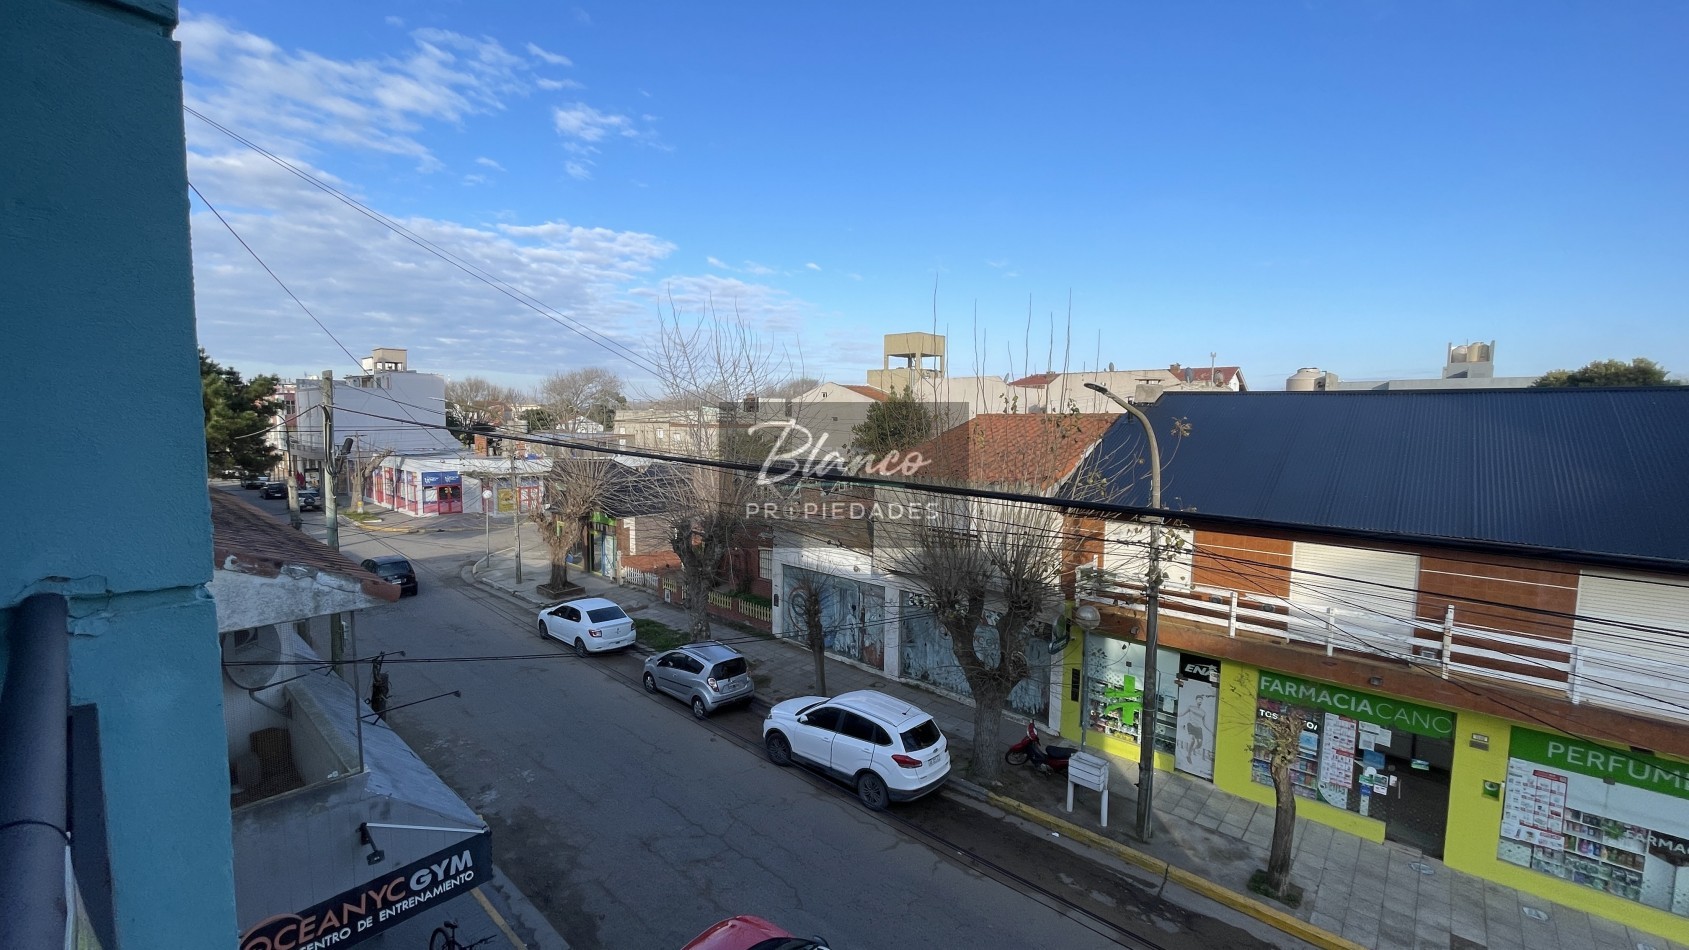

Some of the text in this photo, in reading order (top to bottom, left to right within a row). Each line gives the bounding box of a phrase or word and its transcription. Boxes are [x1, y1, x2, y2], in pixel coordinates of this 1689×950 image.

[1259, 676, 1453, 734] FARMACIA CANO
[1626, 829, 1689, 855] FARMA
[409, 849, 474, 891] GYM
[357, 917, 373, 932] DE
[379, 870, 475, 922] ENTRENAMIENTO
